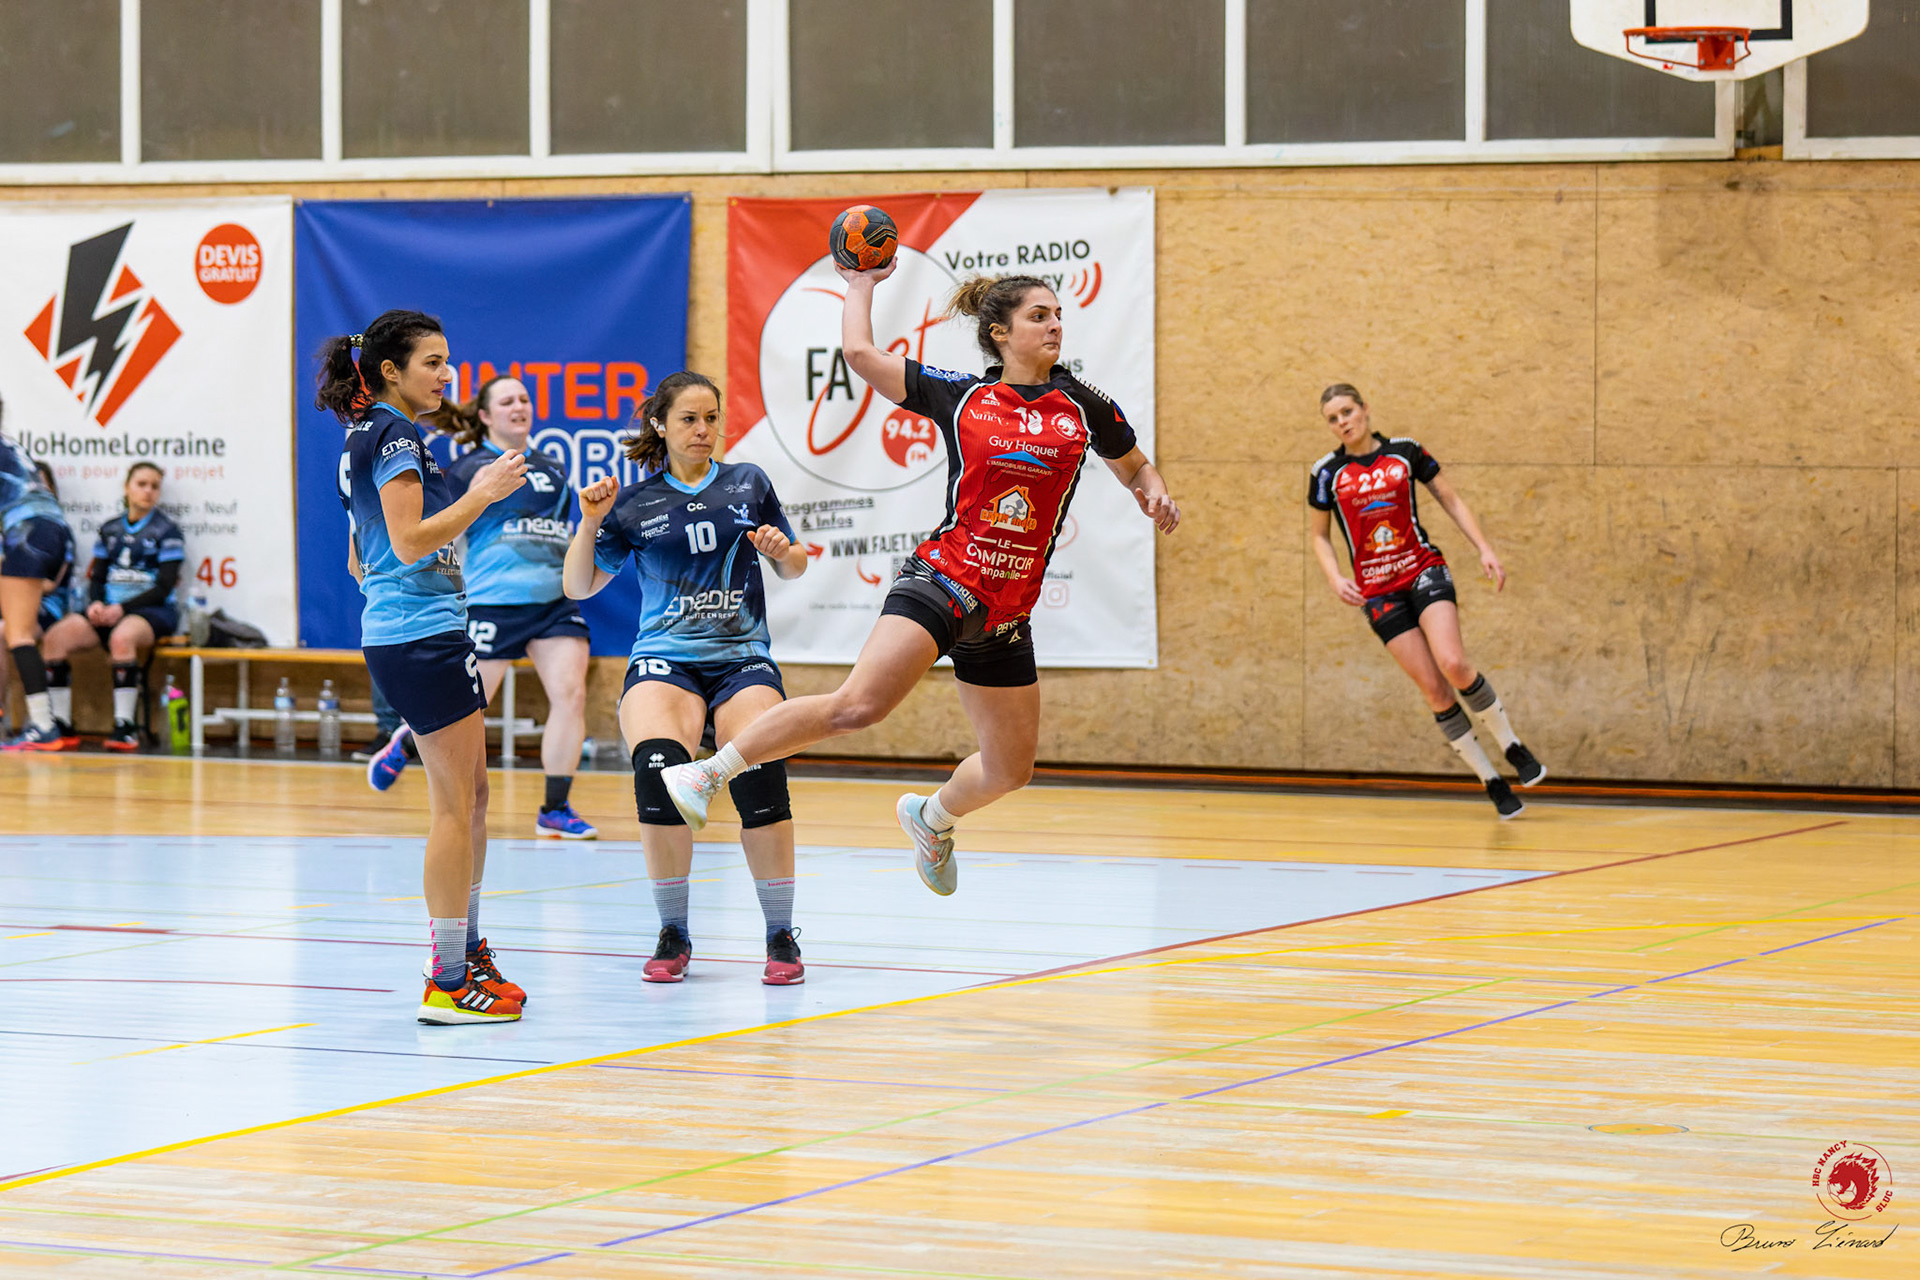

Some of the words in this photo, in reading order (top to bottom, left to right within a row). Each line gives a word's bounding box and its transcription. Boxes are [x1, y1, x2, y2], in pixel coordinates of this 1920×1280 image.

[200, 244, 259, 266] DEVIS
[945, 250, 1009, 270] Votre
[1017, 240, 1090, 264] RADIO
[200, 267, 258, 283] GRATUIT
[885, 418, 931, 440] 94.2
[19, 431, 226, 457] lloHomeLorraine
[989, 435, 1012, 450] Guy
[1015, 440, 1059, 459] Hoquet
[174, 464, 224, 480] projet
[526, 472, 555, 493] 12
[1358, 468, 1387, 493] 22
[204, 501, 238, 514] Neuf
[782, 496, 875, 515] rogrammes
[801, 518, 811, 529] &
[816, 513, 853, 526] Infos
[685, 521, 718, 554] 10
[997, 538, 1011, 549] LE
[468, 620, 498, 653] 12
[635, 659, 672, 676] 10
